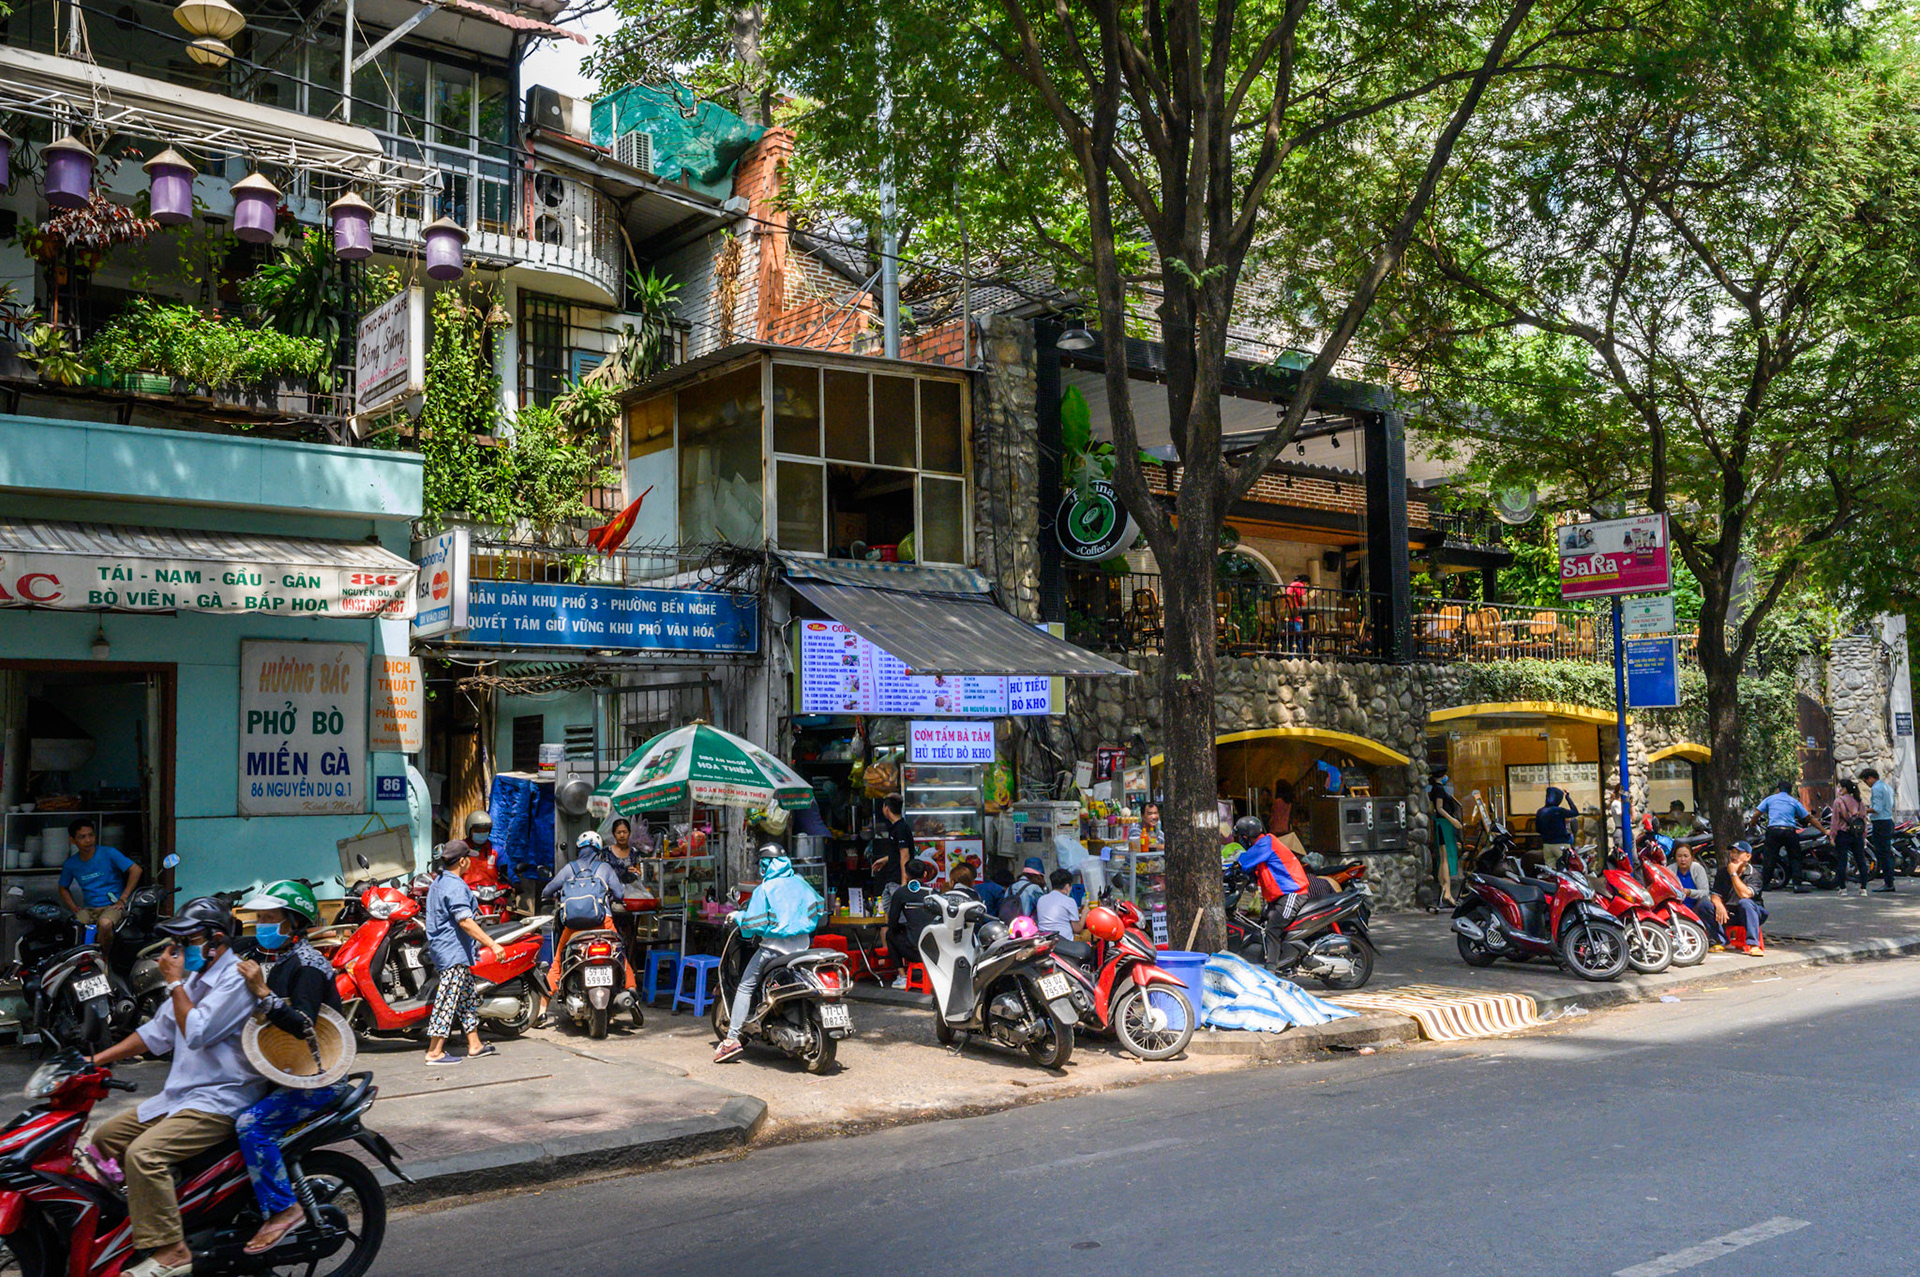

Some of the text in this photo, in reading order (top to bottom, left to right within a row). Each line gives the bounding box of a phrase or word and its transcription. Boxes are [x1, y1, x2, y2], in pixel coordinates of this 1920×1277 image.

[378, 308, 390, 327] CHAY
[1080, 544, 1106, 556] Coffee
[1563, 553, 1619, 578] SaRa
[98, 564, 321, 588] TÁI NẠM GẦU GÂN
[351, 574, 398, 586] 86
[88, 588, 329, 612] BÒ VIÊN GÀ BẮP HOA
[378, 589, 392, 598] DU,
[502, 590, 527, 606] DÂN
[532, 594, 556, 608] KHU
[562, 592, 586, 609] PHỐ
[590, 598, 598, 610] 3
[610, 596, 656, 613] PHƯỜNG
[662, 598, 684, 614] BẾN
[688, 600, 717, 616] NGHÉ
[468, 612, 715, 638] QUYẾT TÂM GIỮ VỮNG KHU PHỐ VĂN HÓA
[320, 652, 350, 694] BẮC
[378, 679, 416, 694] THUẬT
[1010, 677, 1022, 693] HỦ
[1025, 674, 1048, 692] TIẾU
[387, 696, 407, 706] SAO
[1012, 698, 1046, 710] BÒ KHO
[248, 700, 344, 734] PHỞ BÒ
[375, 706, 418, 720] PHƯƠNG
[384, 724, 407, 732] NAM
[914, 727, 934, 742] CƠM
[936, 725, 955, 742] TẤM
[957, 728, 970, 742] BÀ
[247, 741, 350, 776] MIẾN GÀ
[915, 743, 992, 758] HỦ TIẾU BÒ KHO
[697, 762, 720, 770] HOA
[251, 777, 351, 797] 86 NGUYỄN DU Q.1
[383, 778, 400, 792] 86
[294, 896, 315, 912] Grab
